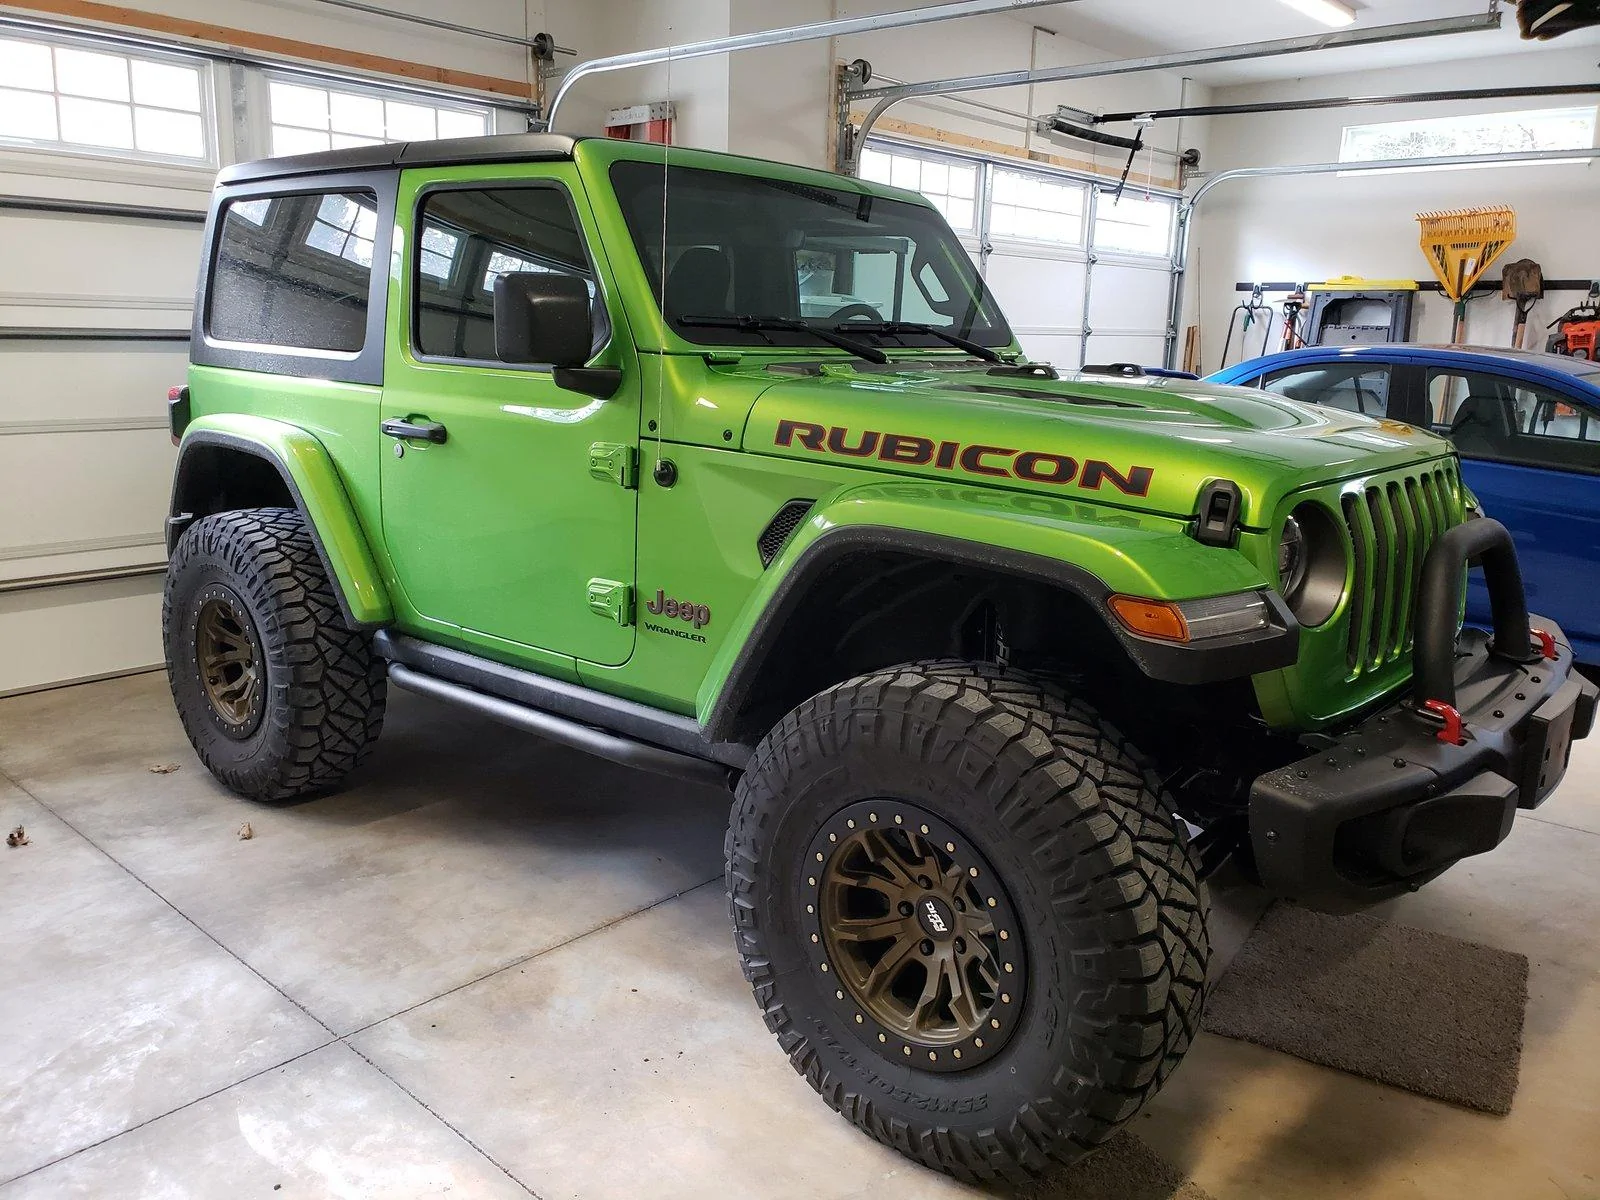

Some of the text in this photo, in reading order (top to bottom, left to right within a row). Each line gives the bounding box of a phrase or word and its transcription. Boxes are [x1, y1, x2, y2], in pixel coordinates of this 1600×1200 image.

[774, 419, 1154, 497] RUBICON
[646, 589, 710, 629] Jeep
[644, 621, 706, 644] WRANGLER
